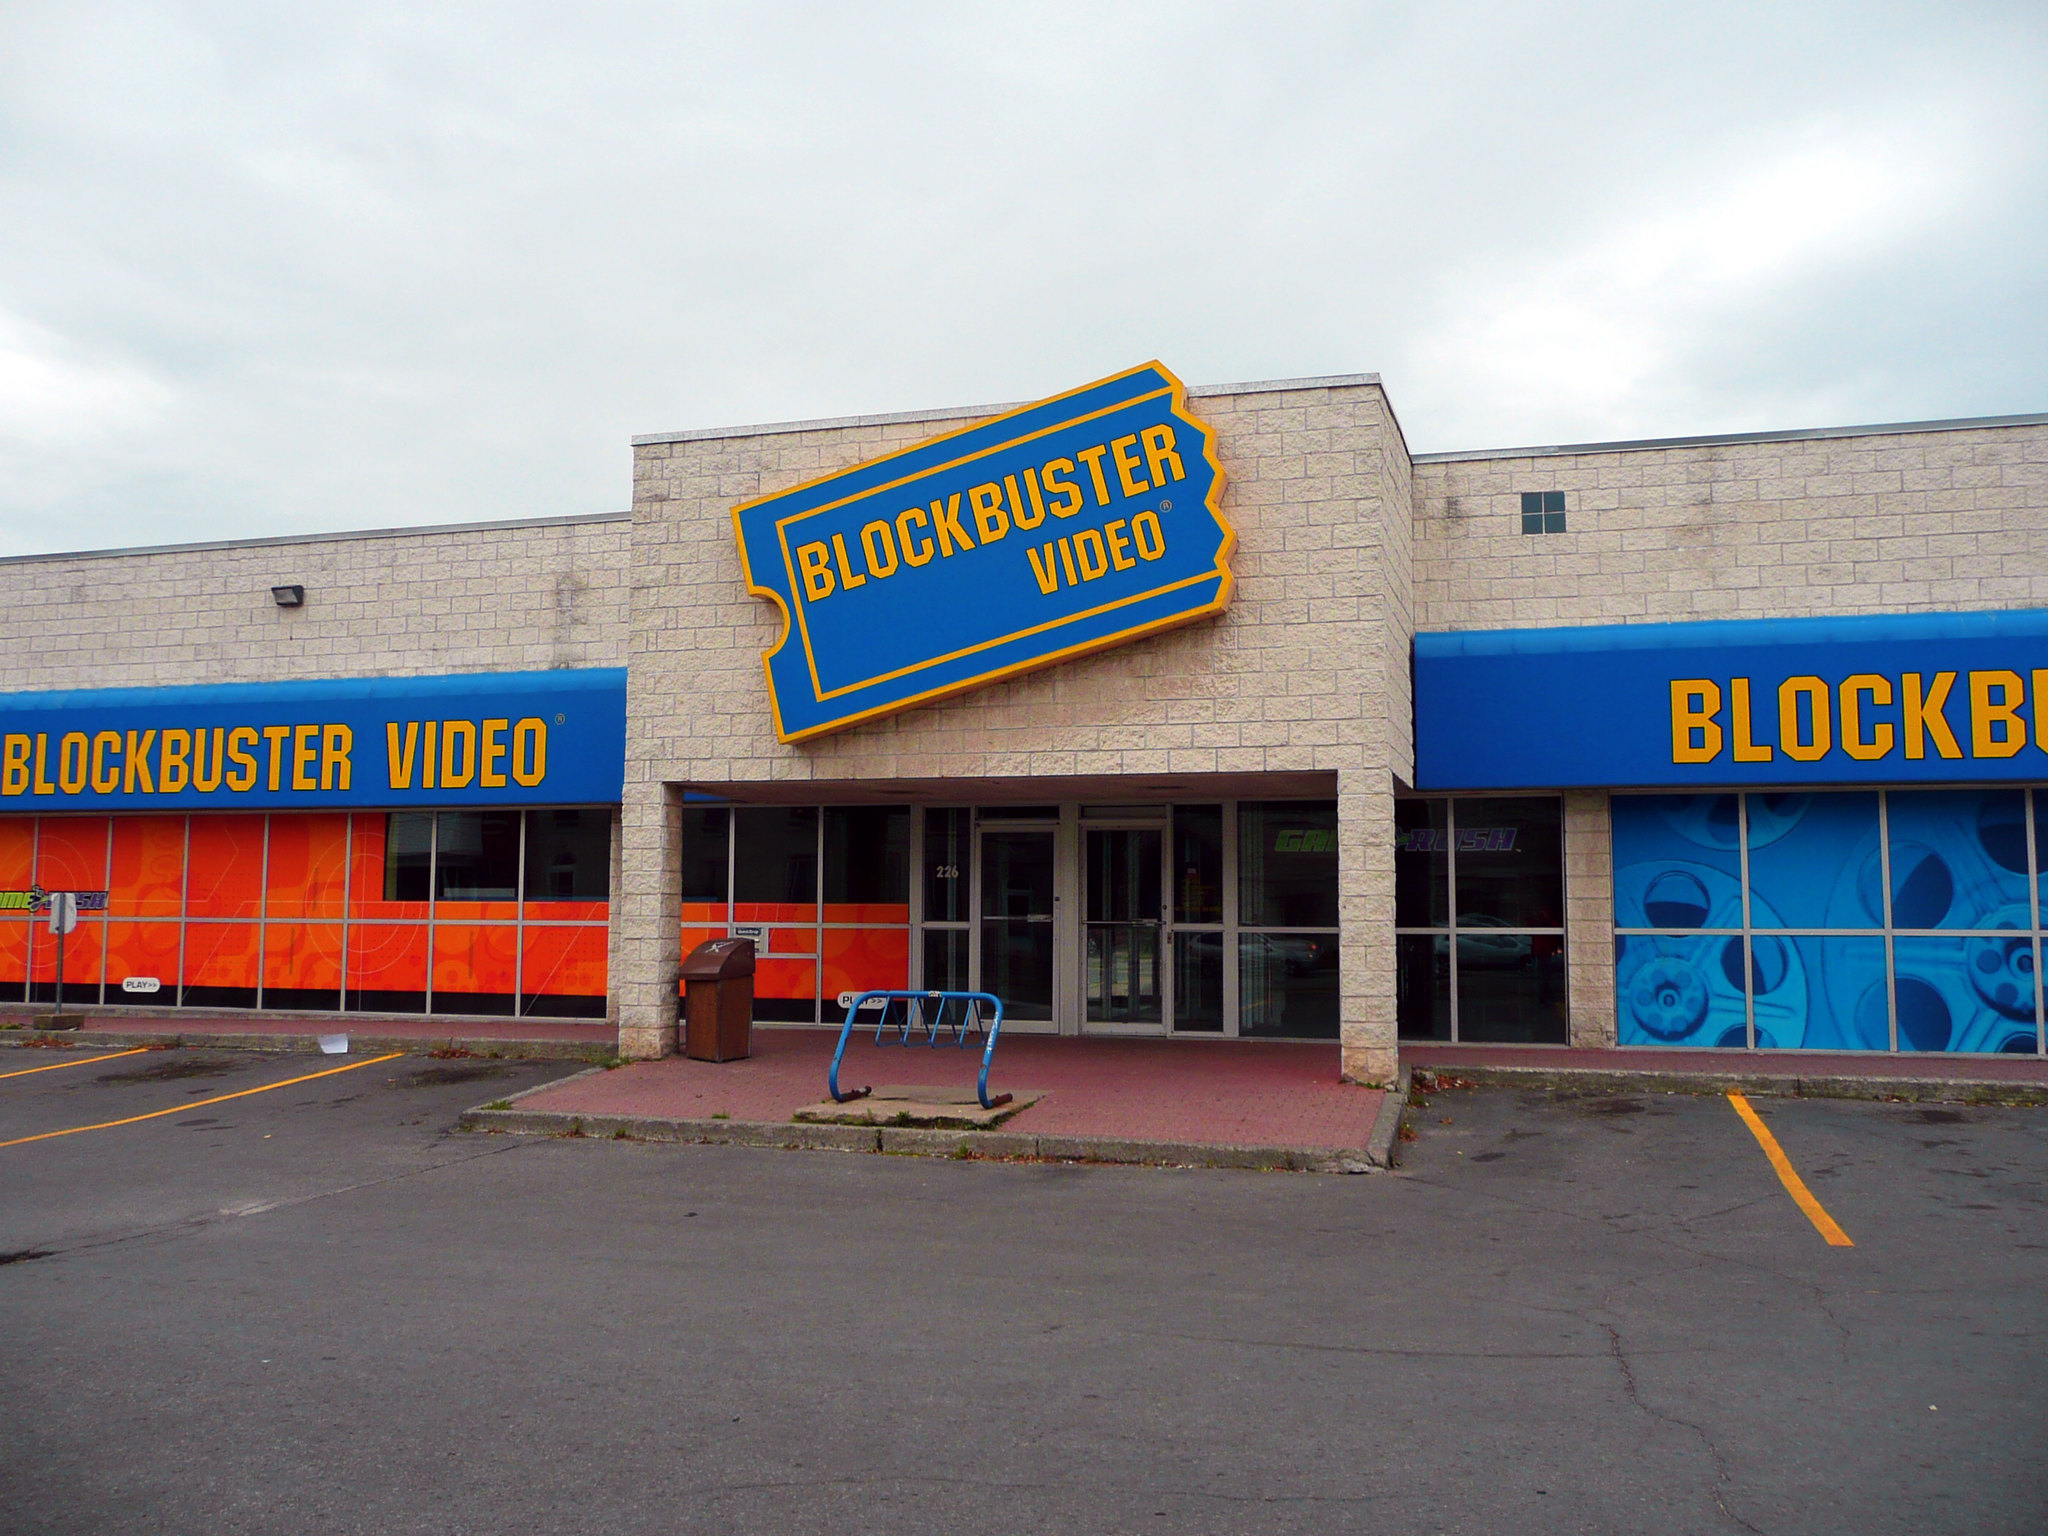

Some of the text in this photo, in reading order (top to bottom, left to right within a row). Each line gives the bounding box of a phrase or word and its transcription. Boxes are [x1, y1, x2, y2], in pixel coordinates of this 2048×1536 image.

[795, 422, 1187, 604] BLOCKBUSTER
[1025, 509, 1168, 597] VIDEO
[1, 717, 549, 796] BLOCKBUSTER VIDEO
[1275, 828, 1518, 851] GA RUSH
[936, 865, 959, 878] 226
[0, 891, 35, 909] ME
[125, 980, 148, 989] PLAY
